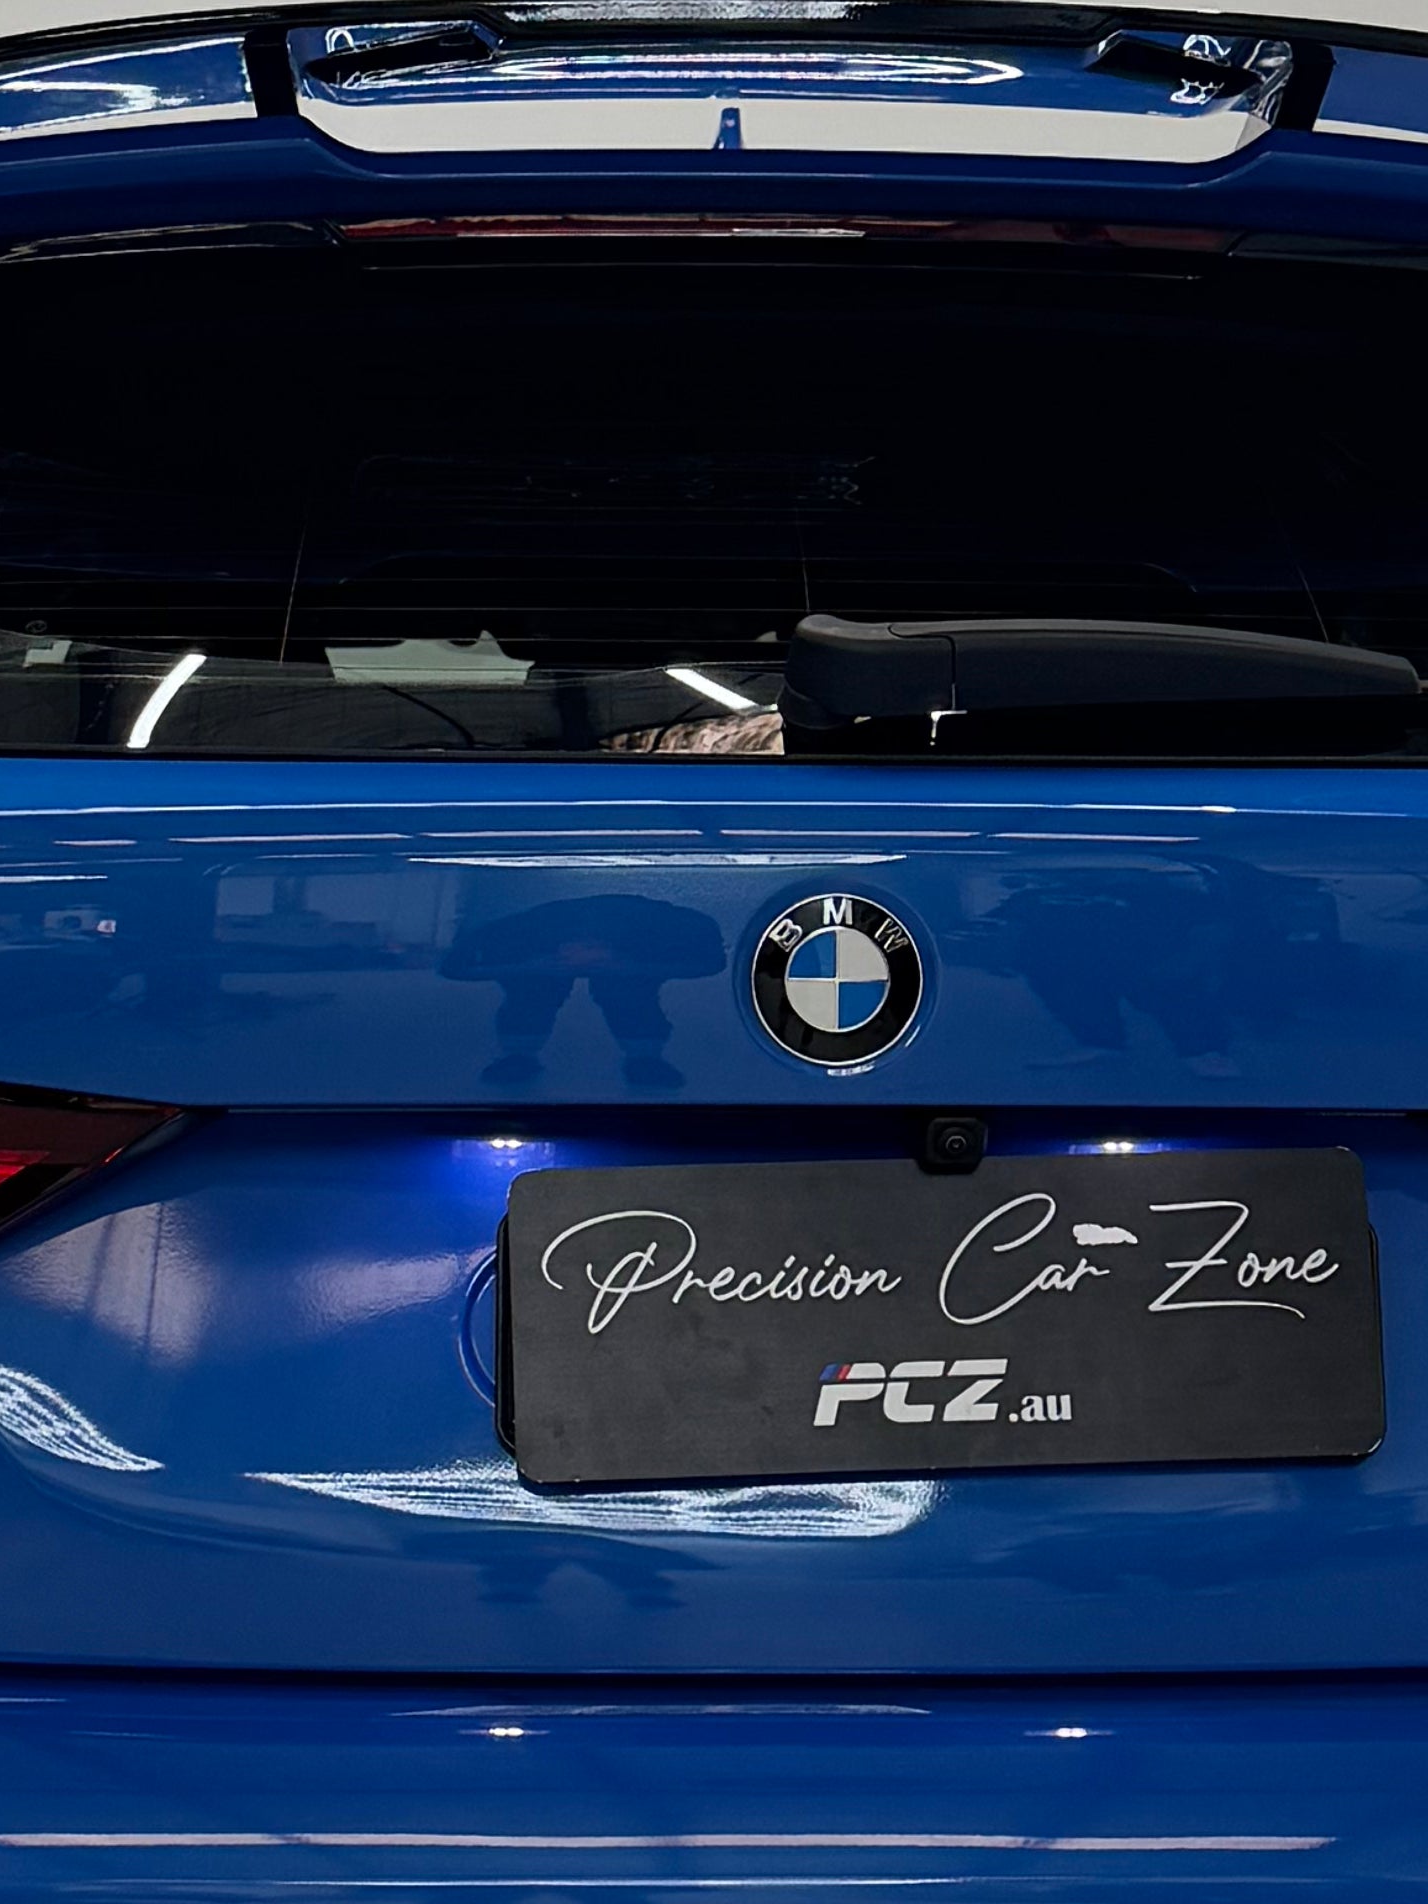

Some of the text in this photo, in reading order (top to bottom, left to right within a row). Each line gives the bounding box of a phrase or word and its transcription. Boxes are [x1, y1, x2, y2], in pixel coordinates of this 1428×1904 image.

[768, 897, 909, 953] BMW
[540, 1192, 1340, 1334] Precision Car Zone
